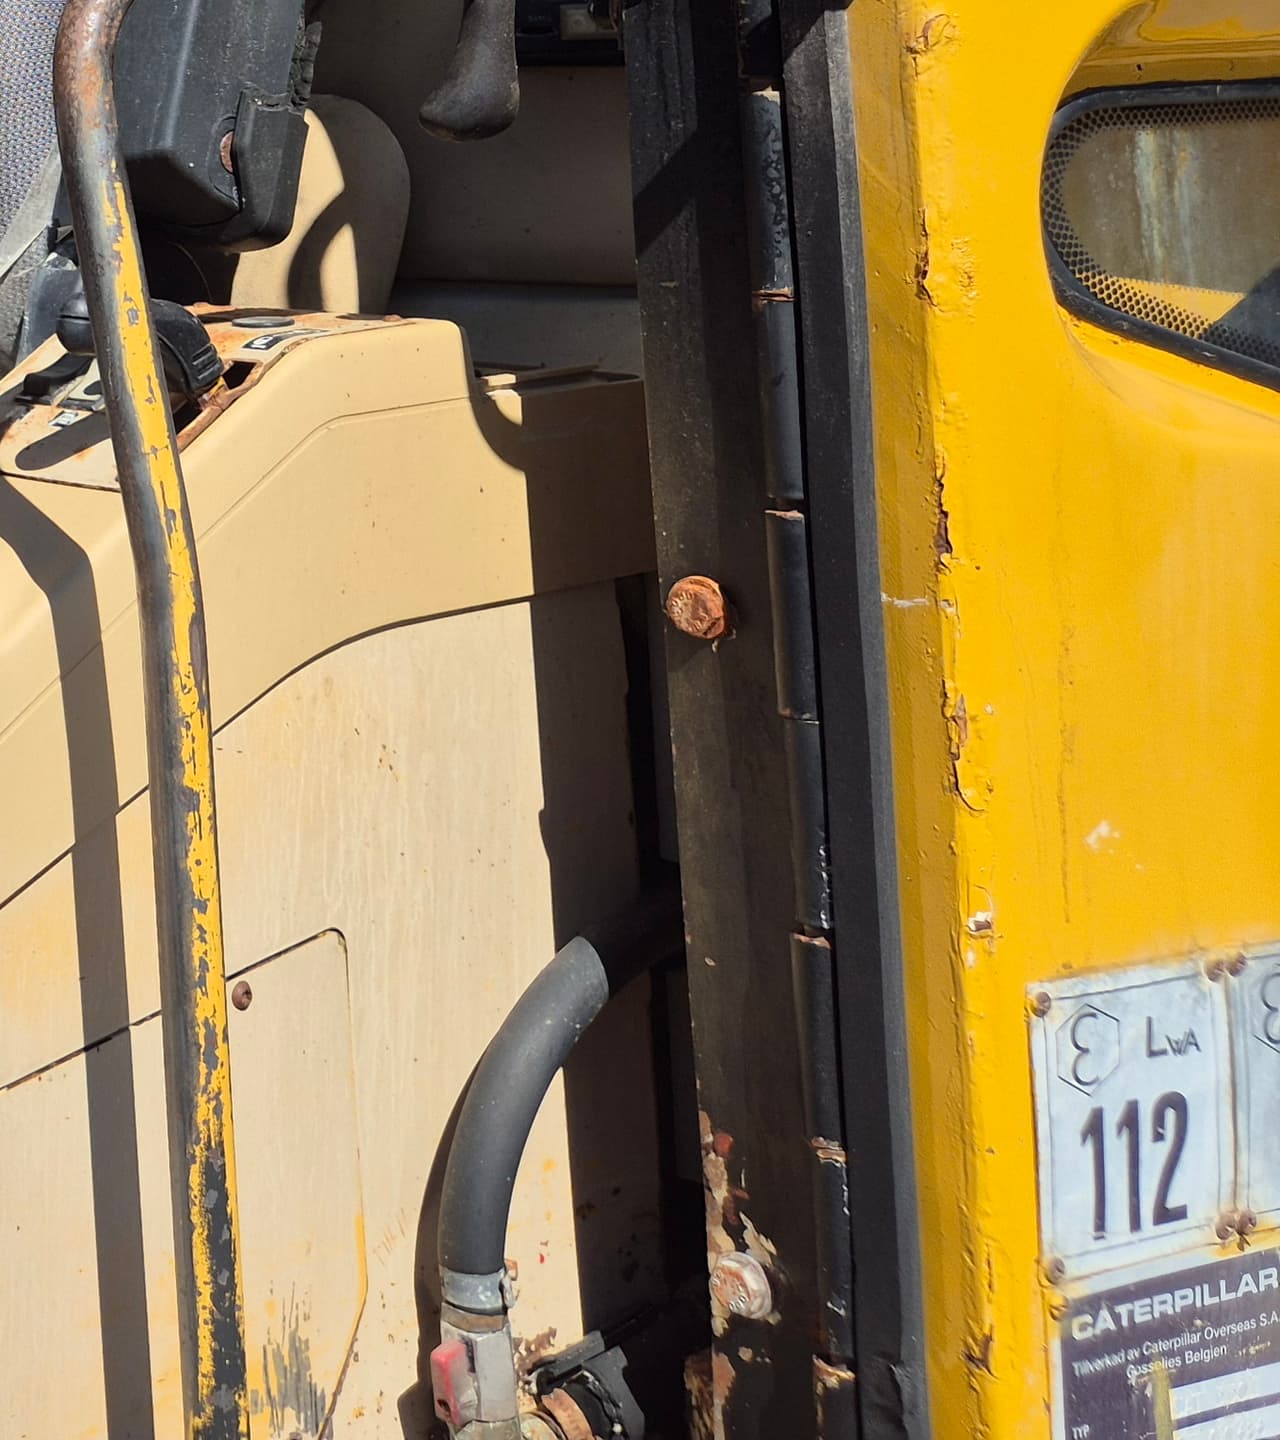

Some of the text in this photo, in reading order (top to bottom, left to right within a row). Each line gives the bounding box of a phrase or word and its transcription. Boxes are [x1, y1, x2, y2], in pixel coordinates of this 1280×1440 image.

[1080, 1090, 1188, 1241] 112
[1070, 1266, 1280, 1341] CATERPILLAR
[1125, 1343, 1228, 1379] Gosselies Belgien
[1142, 1331, 1201, 1357] Caterpillar
[1204, 1317, 1257, 1341] Overseas
